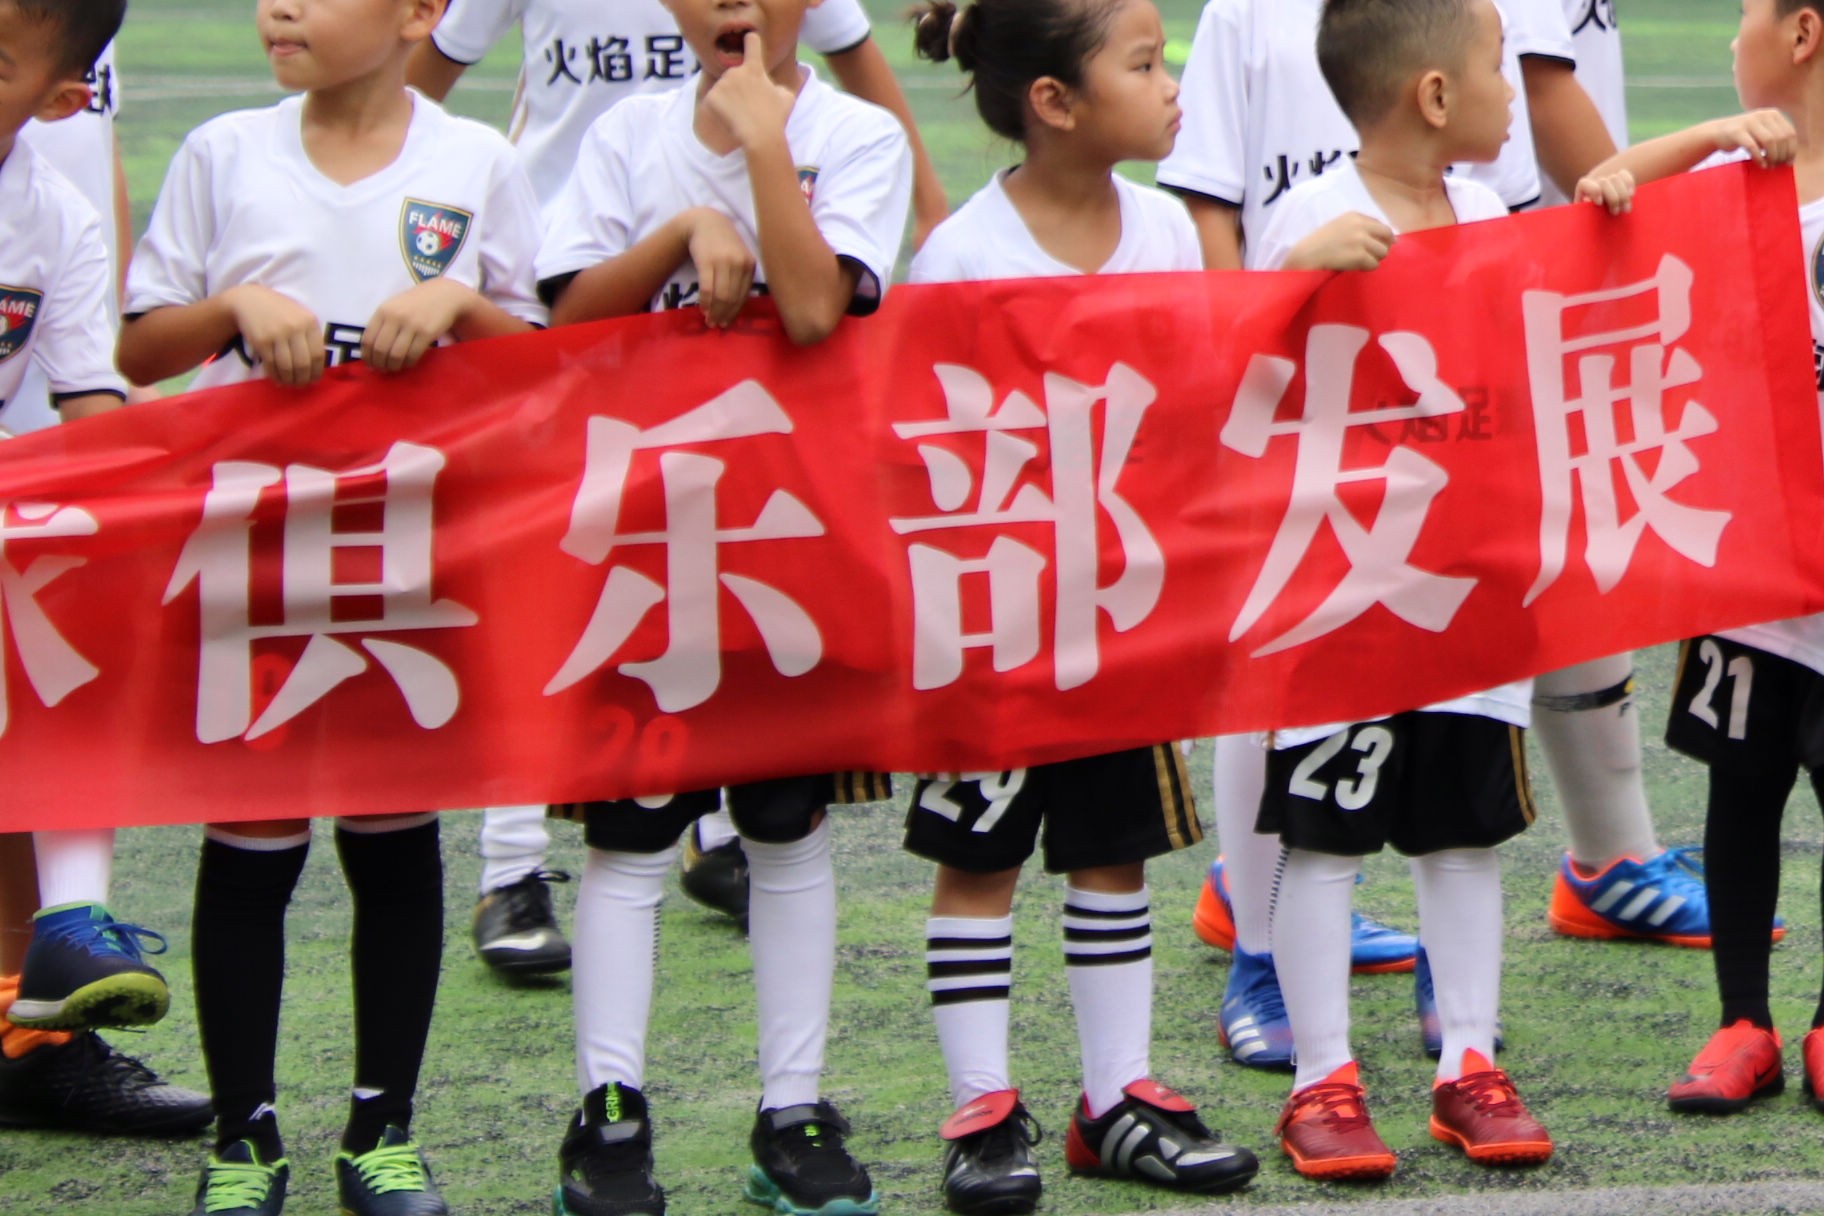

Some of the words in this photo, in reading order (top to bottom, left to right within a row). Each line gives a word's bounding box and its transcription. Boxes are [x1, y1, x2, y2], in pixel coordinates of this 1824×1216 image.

[544, 34, 703, 86] 火焰足
[409, 210, 462, 239] FLAME
[1688, 639, 1754, 740] 21
[1288, 725, 1395, 811] 23
